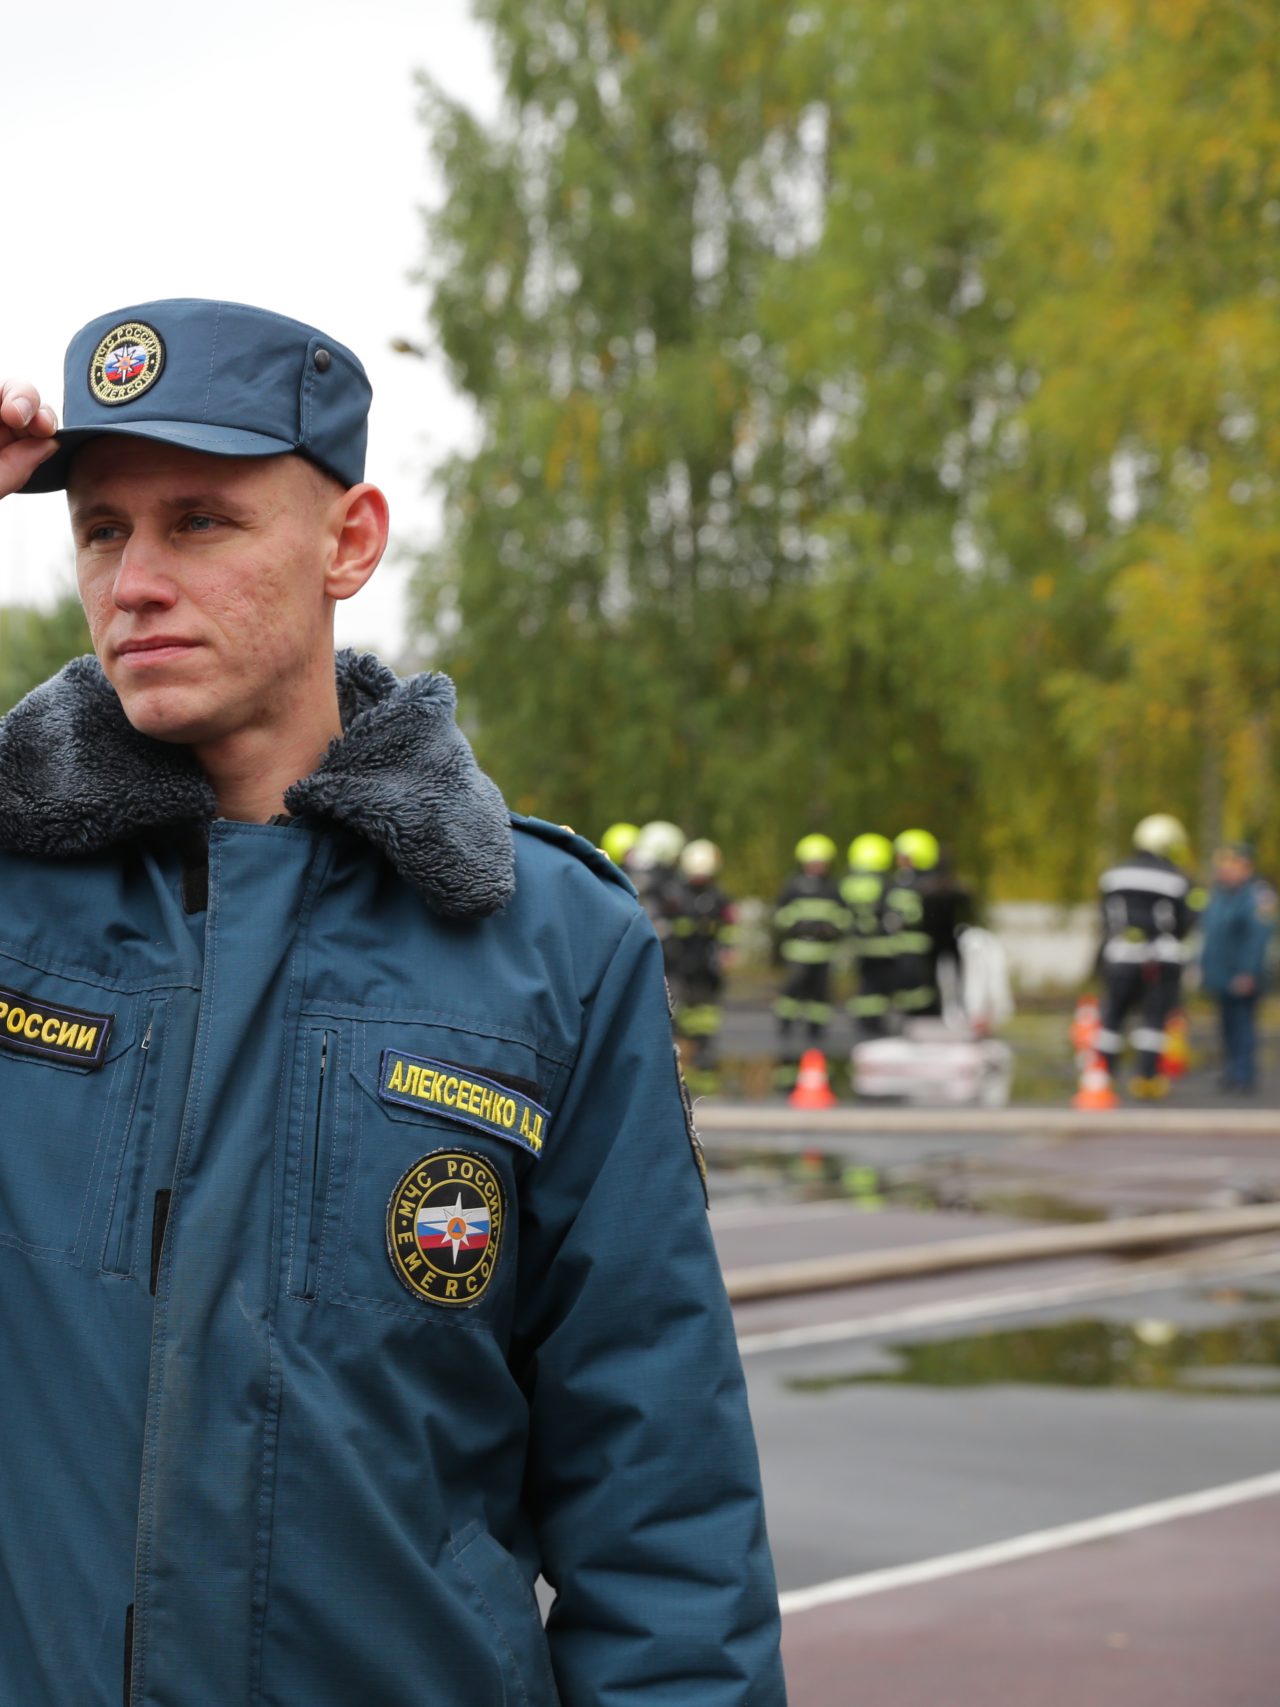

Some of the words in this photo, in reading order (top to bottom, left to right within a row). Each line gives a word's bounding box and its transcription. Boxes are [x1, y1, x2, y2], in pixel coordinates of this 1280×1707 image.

[95, 337, 115, 367] МЧС
[116, 327, 157, 355] РОССИИ
[97, 370, 152, 398] EMERCOM
[388, 1061, 516, 1128] АЛЕКСЕЕНКО
[398, 1171, 432, 1218] МЧС
[447, 1160, 500, 1228] РОССИИ
[397, 1231, 498, 1297] EMERCOM
